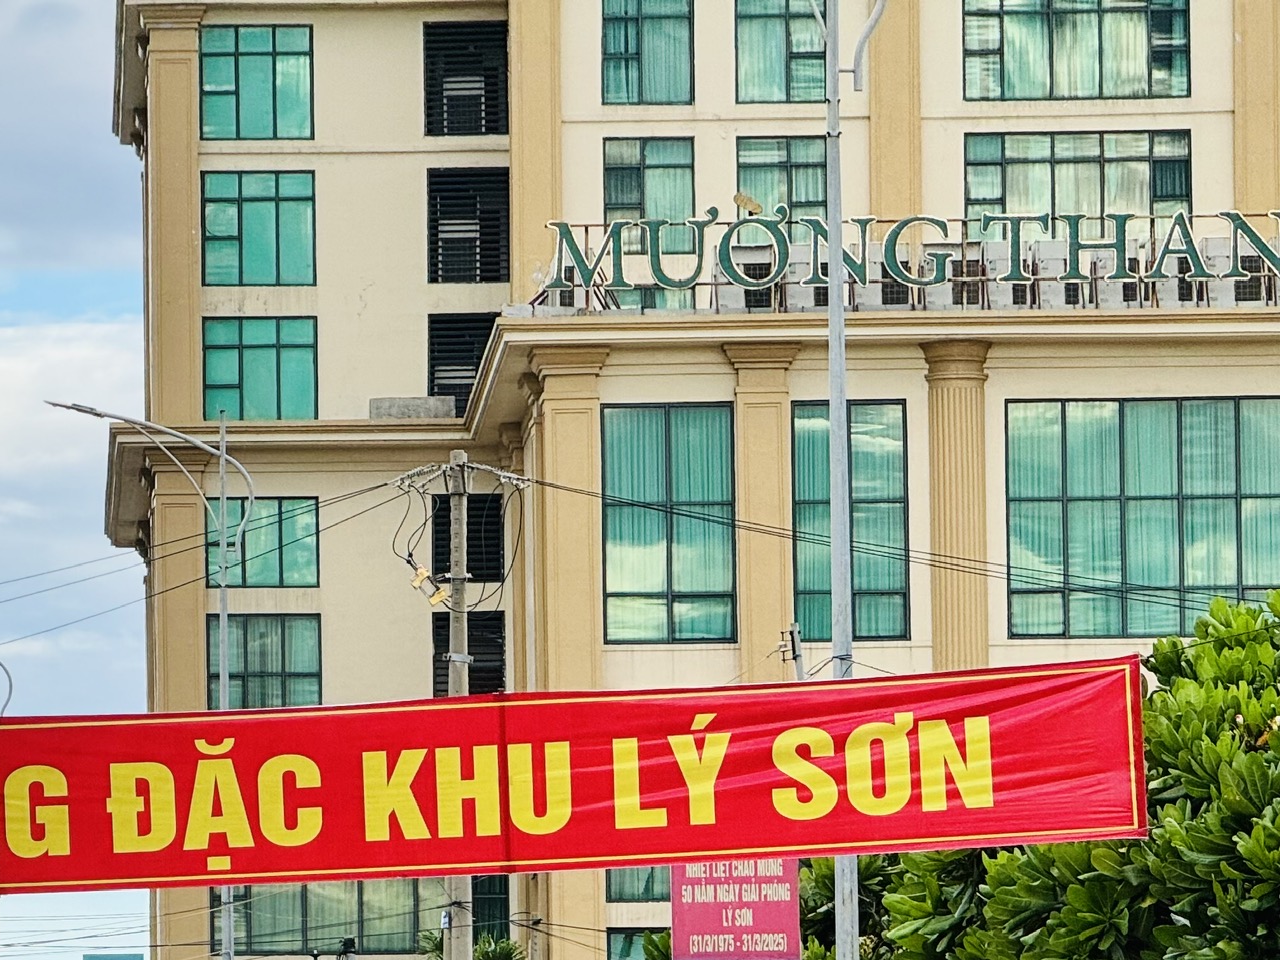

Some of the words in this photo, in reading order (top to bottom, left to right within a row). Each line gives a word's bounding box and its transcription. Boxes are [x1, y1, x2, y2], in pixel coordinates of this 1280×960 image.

[107, 738, 323, 872] ĐẶC
[362, 740, 572, 843] KHU
[613, 713, 731, 830] LÝ
[771, 711, 995, 822] SƠN
[681, 885, 693, 903] 50
[717, 880, 740, 902] NGÀY
[742, 878, 759, 902] GIẢI
[762, 880, 791, 901] PHÓNG
[722, 905, 733, 927] LÝ
[735, 906, 753, 927] SƠN
[689, 934, 735, 955] (31/3/1975
[742, 933, 788, 953] 31/3/2025)
